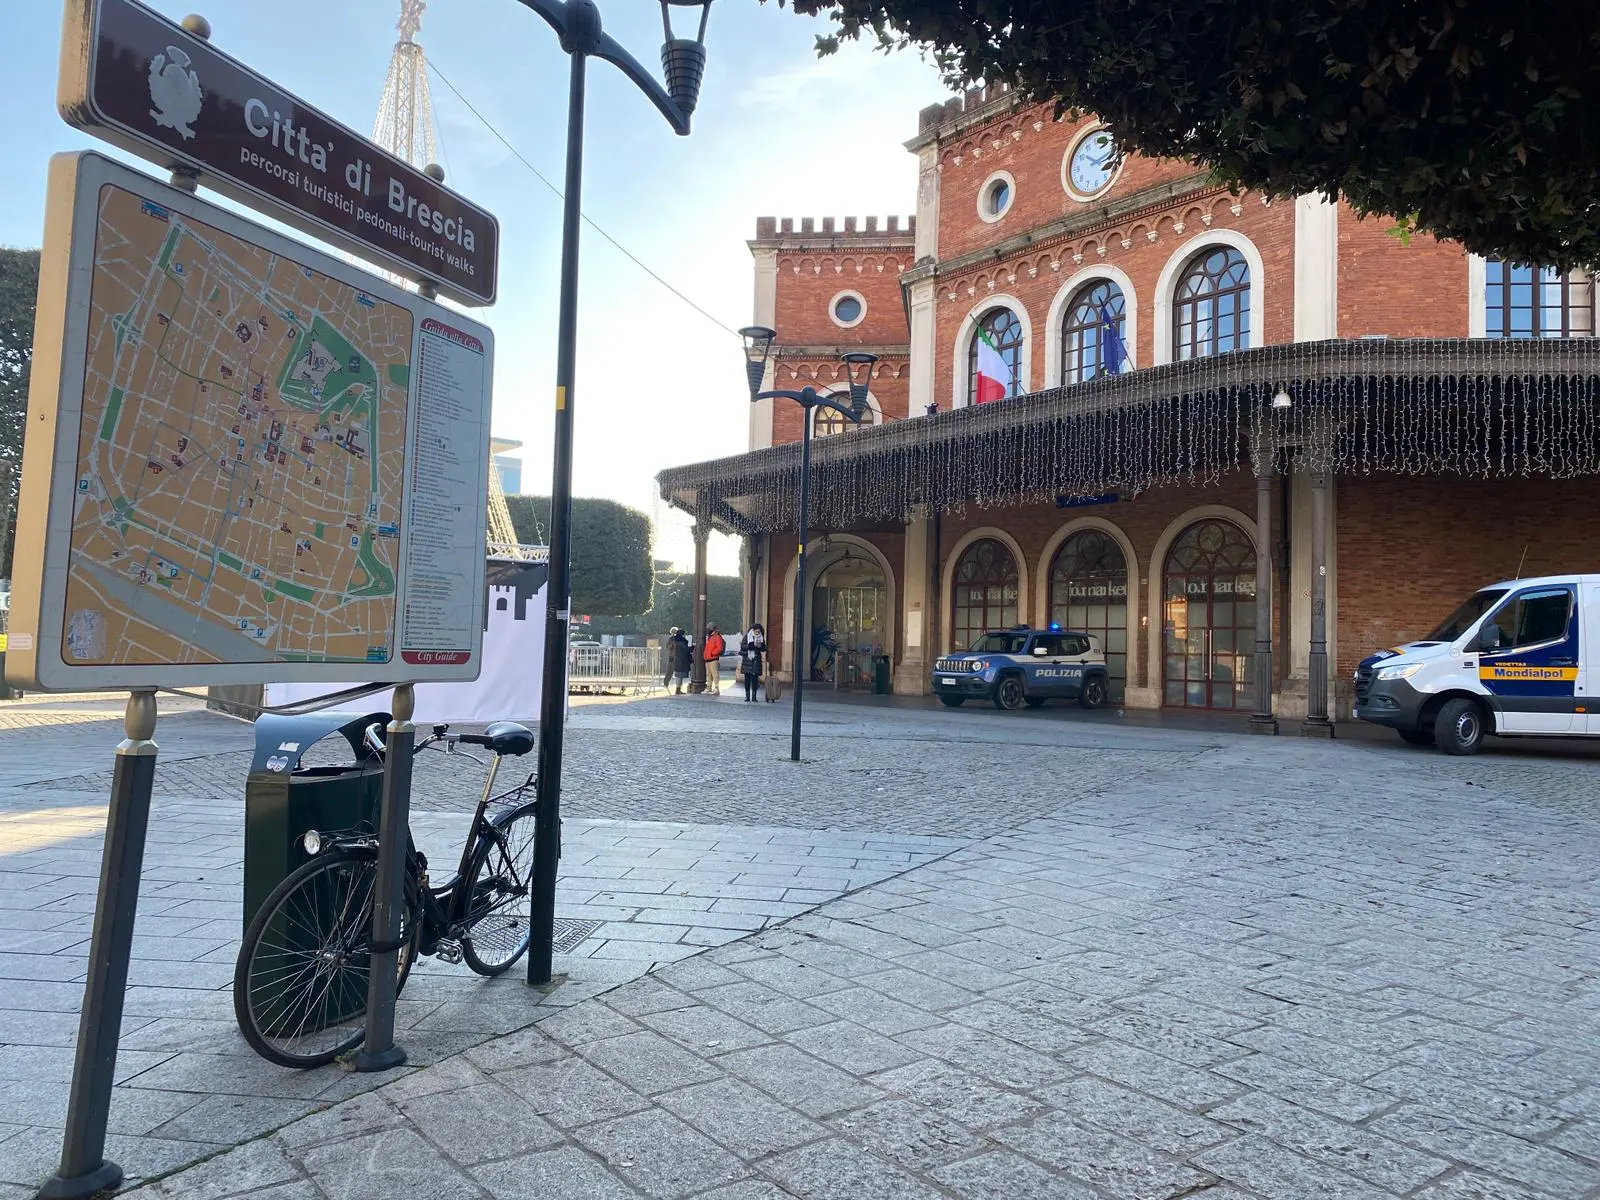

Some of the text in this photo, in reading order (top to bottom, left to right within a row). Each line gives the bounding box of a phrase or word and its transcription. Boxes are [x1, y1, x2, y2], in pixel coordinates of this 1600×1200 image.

[244, 98, 475, 253] Citta' di Brescia
[240, 146, 475, 276] percorsi turistici pedonali-tourist walks
[425, 322, 448, 337] Guida
[449, 333, 463, 344] alla
[417, 652, 458, 663] City Guide
[1036, 669, 1082, 678] POLIZIA
[1494, 668, 1563, 679] Mondialpol
